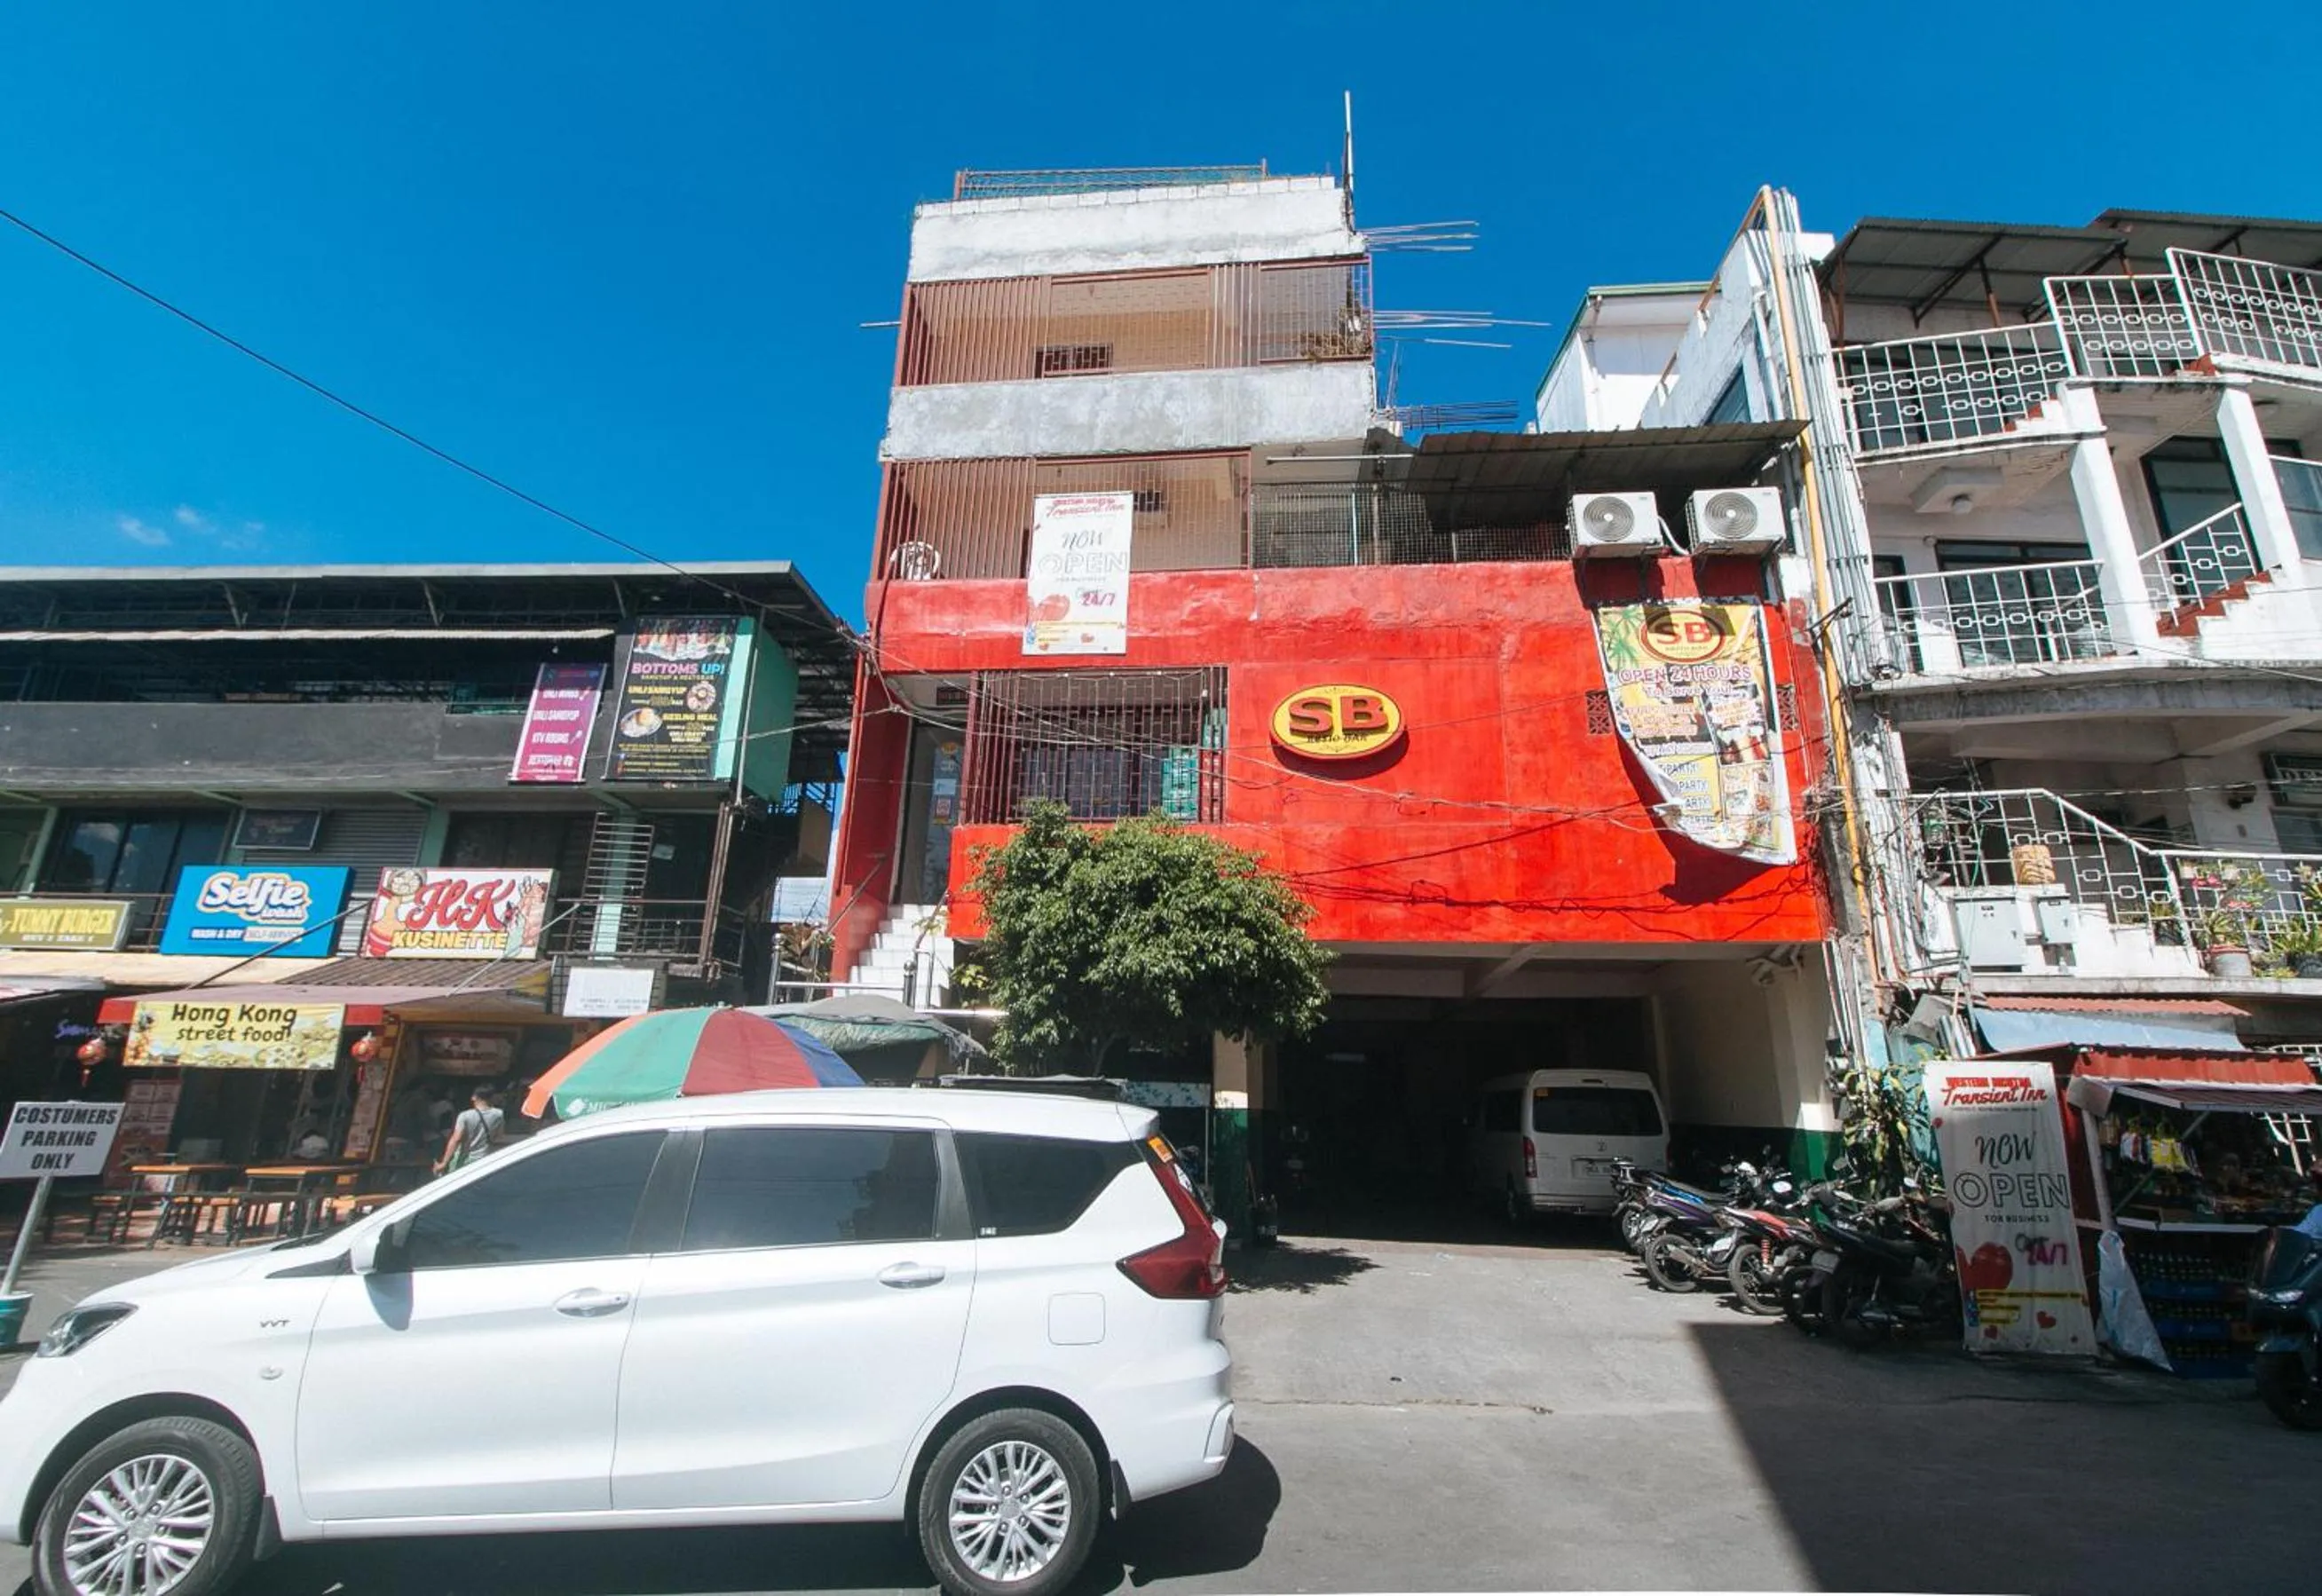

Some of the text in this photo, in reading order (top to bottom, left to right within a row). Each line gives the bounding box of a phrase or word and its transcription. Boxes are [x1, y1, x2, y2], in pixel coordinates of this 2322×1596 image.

[1038, 551, 1128, 574] OPEN
[1081, 592, 1116, 606] 24/7
[1655, 622, 1713, 645] SB
[631, 663, 725, 675] BOTTOMS UP!
[1619, 665, 1752, 683] OPEN 24 HOURS
[1288, 694, 1390, 736] SB
[1678, 778, 1708, 791] PARTY
[202, 877, 304, 914] Selfie
[405, 878, 516, 932] HK
[11, 908, 63, 934] YUMMY
[59, 908, 116, 934] BURGER
[391, 932, 508, 949] KUSINETTE
[171, 1004, 297, 1031] Hong Kong
[177, 1025, 236, 1041] street
[1941, 1086, 2049, 1106] Transient Inn
[14, 1107, 118, 1125] COSTUMERS
[20, 1130, 98, 1147] PARKING
[30, 1153, 75, 1170] ONLY
[1953, 1172, 2070, 1209] OPEN
[2005, 1214, 2050, 1223] BUSINESS
[259, 1319, 291, 1328] VVT
